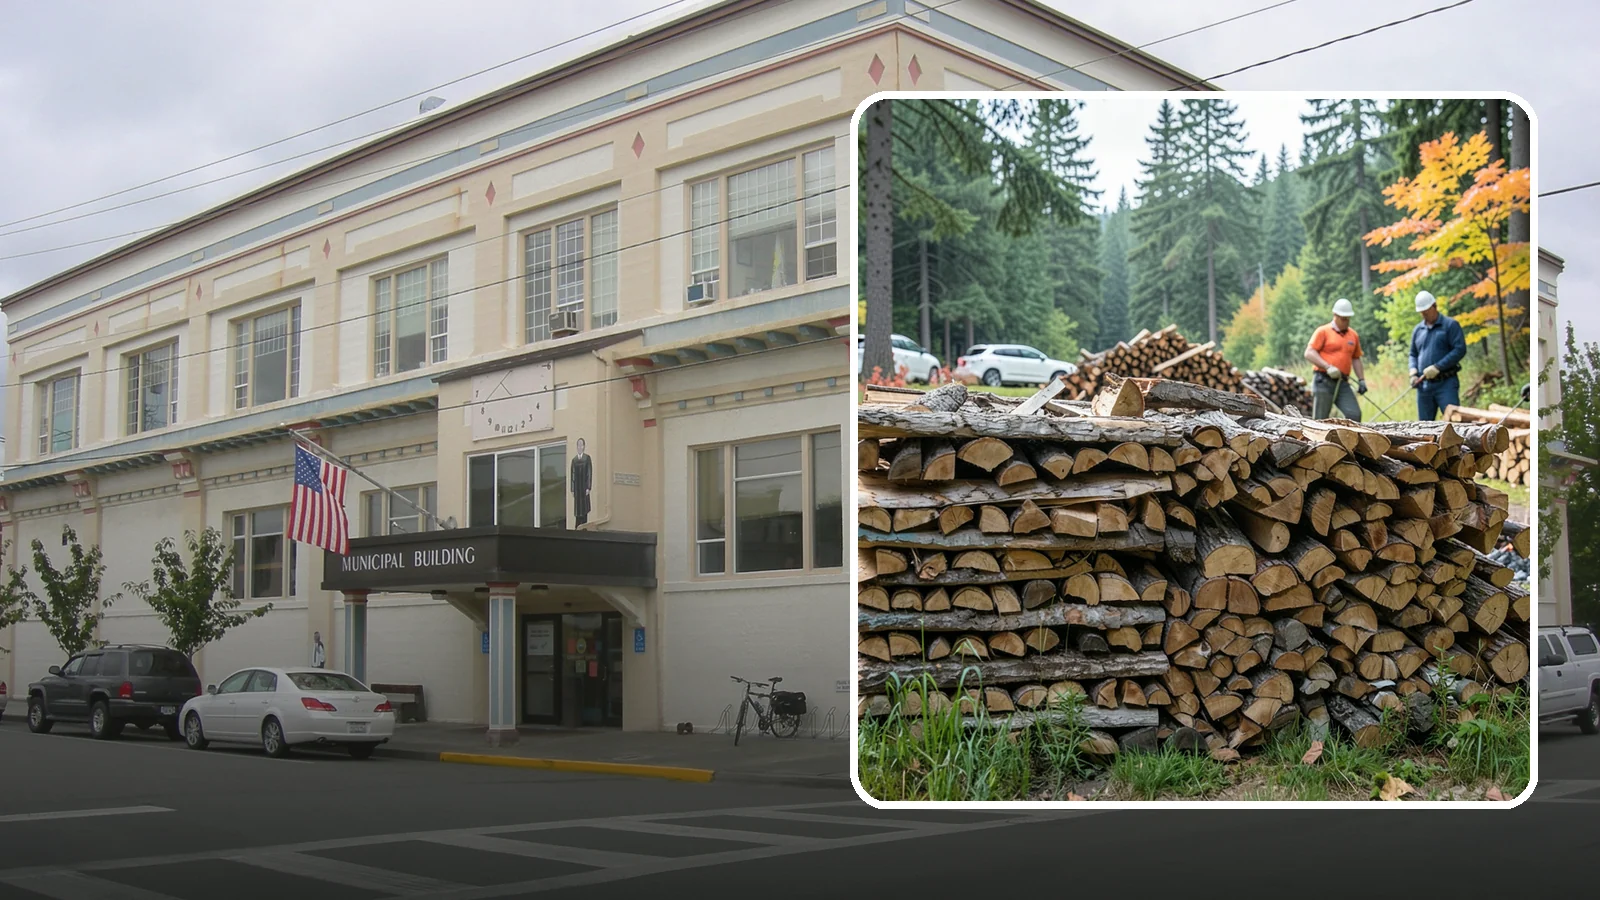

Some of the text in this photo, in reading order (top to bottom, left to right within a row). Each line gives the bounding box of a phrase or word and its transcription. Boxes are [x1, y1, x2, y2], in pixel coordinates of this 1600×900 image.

[481, 406, 485, 415] 8
[487, 417, 492, 426] 9
[495, 424, 500, 432] 10
[507, 425, 513, 433] 12
[521, 420, 525, 428] 2
[529, 413, 533, 422] 3
[342, 546, 475, 571] MUNICIPAL BUILDING
